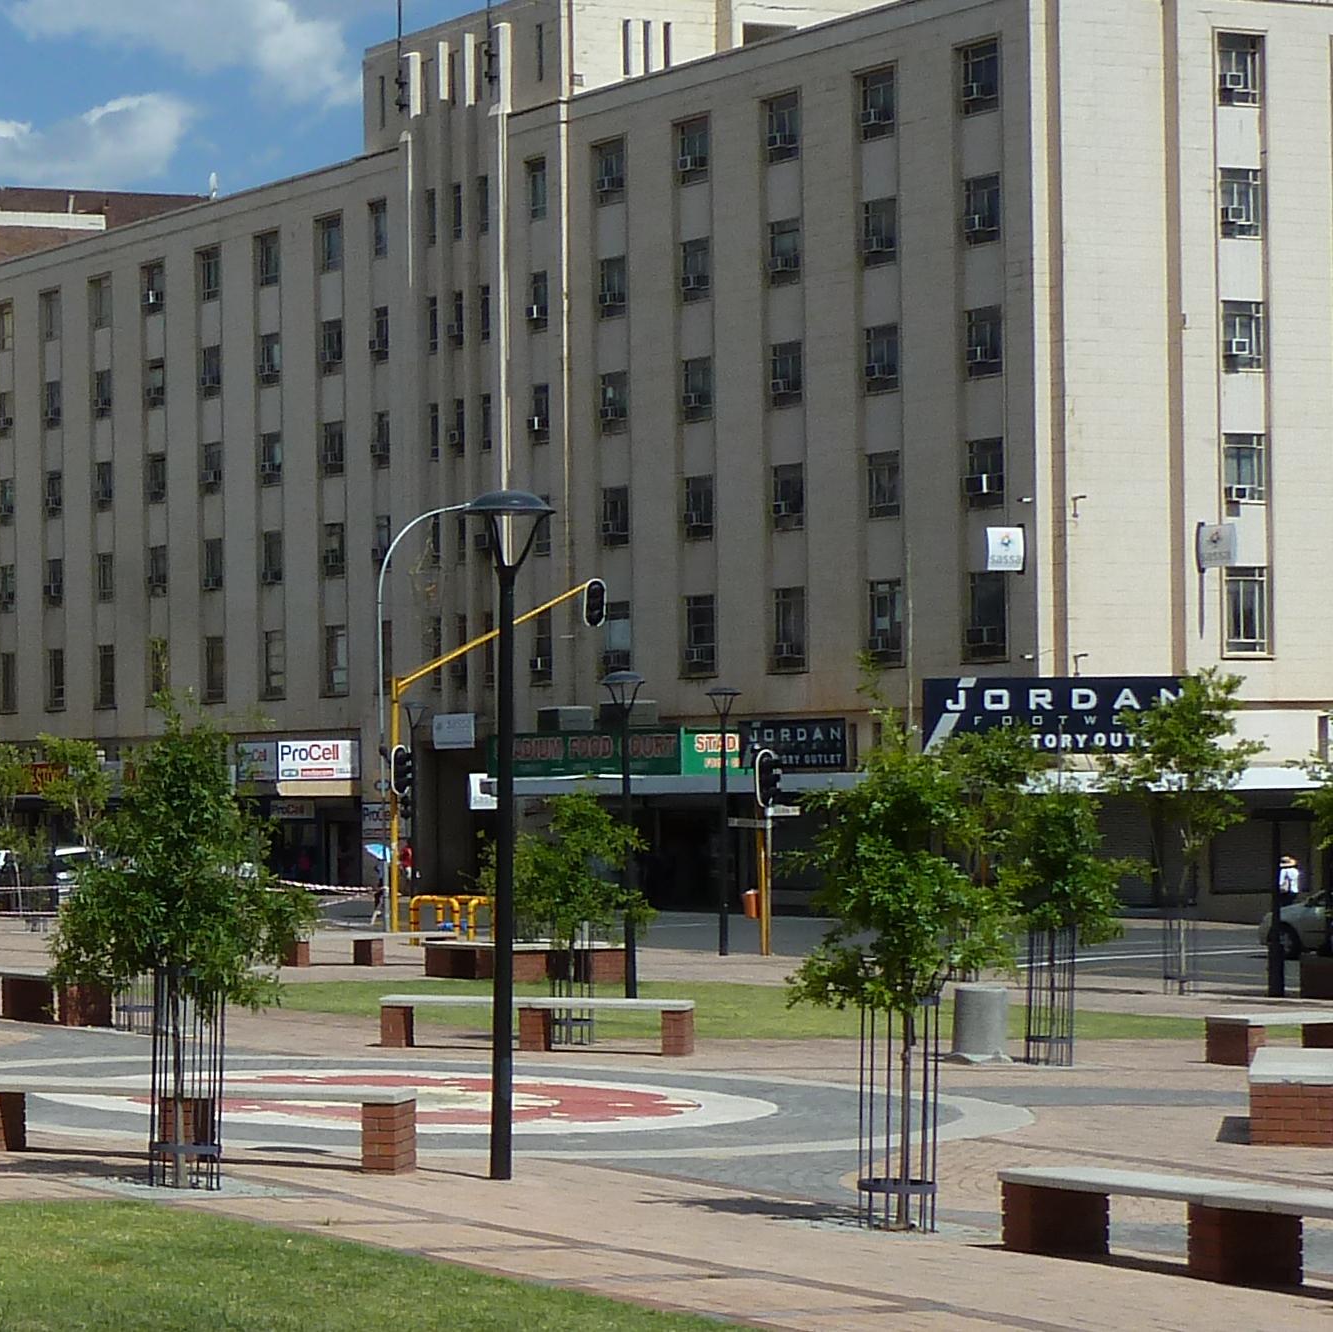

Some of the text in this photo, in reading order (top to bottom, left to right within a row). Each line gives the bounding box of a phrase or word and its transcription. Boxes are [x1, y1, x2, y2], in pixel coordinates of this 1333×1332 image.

[990, 554, 1022, 565] sassa
[946, 688, 1184, 711] JORDAN
[749, 727, 841, 742] JORDAN
[280, 743, 340, 761] ProCell
[568, 735, 614, 760] FOOD
[804, 752, 842, 764] OUTLET
